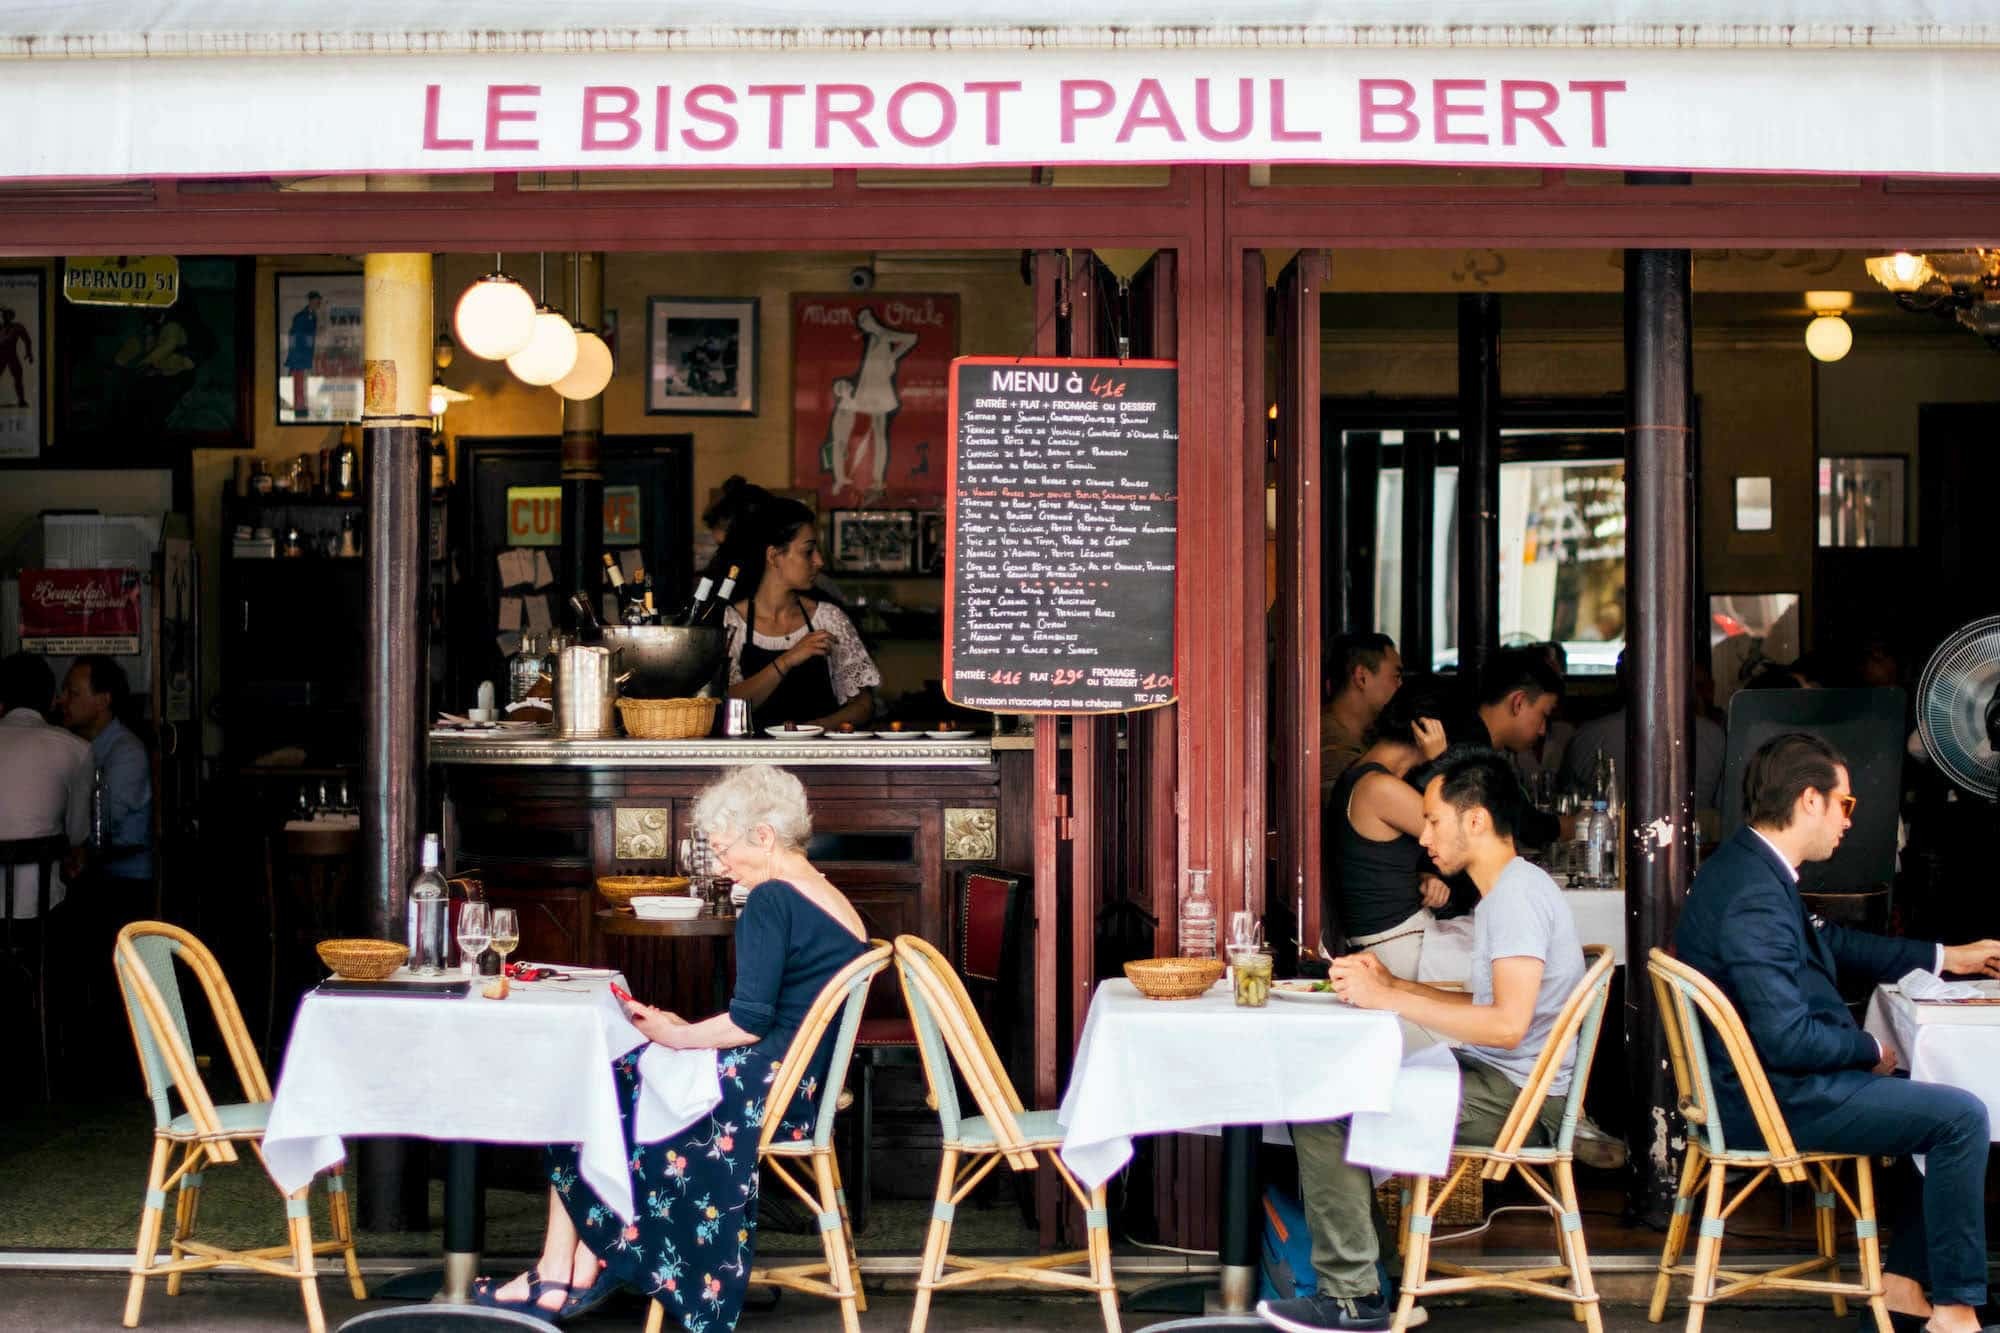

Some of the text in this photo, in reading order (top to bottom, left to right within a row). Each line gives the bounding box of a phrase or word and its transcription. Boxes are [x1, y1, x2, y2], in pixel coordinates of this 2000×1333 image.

[423, 78, 1627, 152] LE BISTROT PAUL BERT
[69, 268, 175, 291] PERNOD 51
[992, 370, 1059, 393] MENU
[1066, 371, 1083, 394] à
[975, 397, 1007, 409] ENTRÉE
[1020, 399, 1040, 410] PLAT
[1052, 400, 1098, 411] FROMAGE
[1120, 401, 1158, 412] DESSERT
[955, 668, 986, 680] ENTRÉE
[1029, 671, 1048, 682] PLAT
[1091, 667, 1136, 678] FROMAGE
[1103, 678, 1138, 688] DESSERT
[976, 696, 1007, 706] maison
